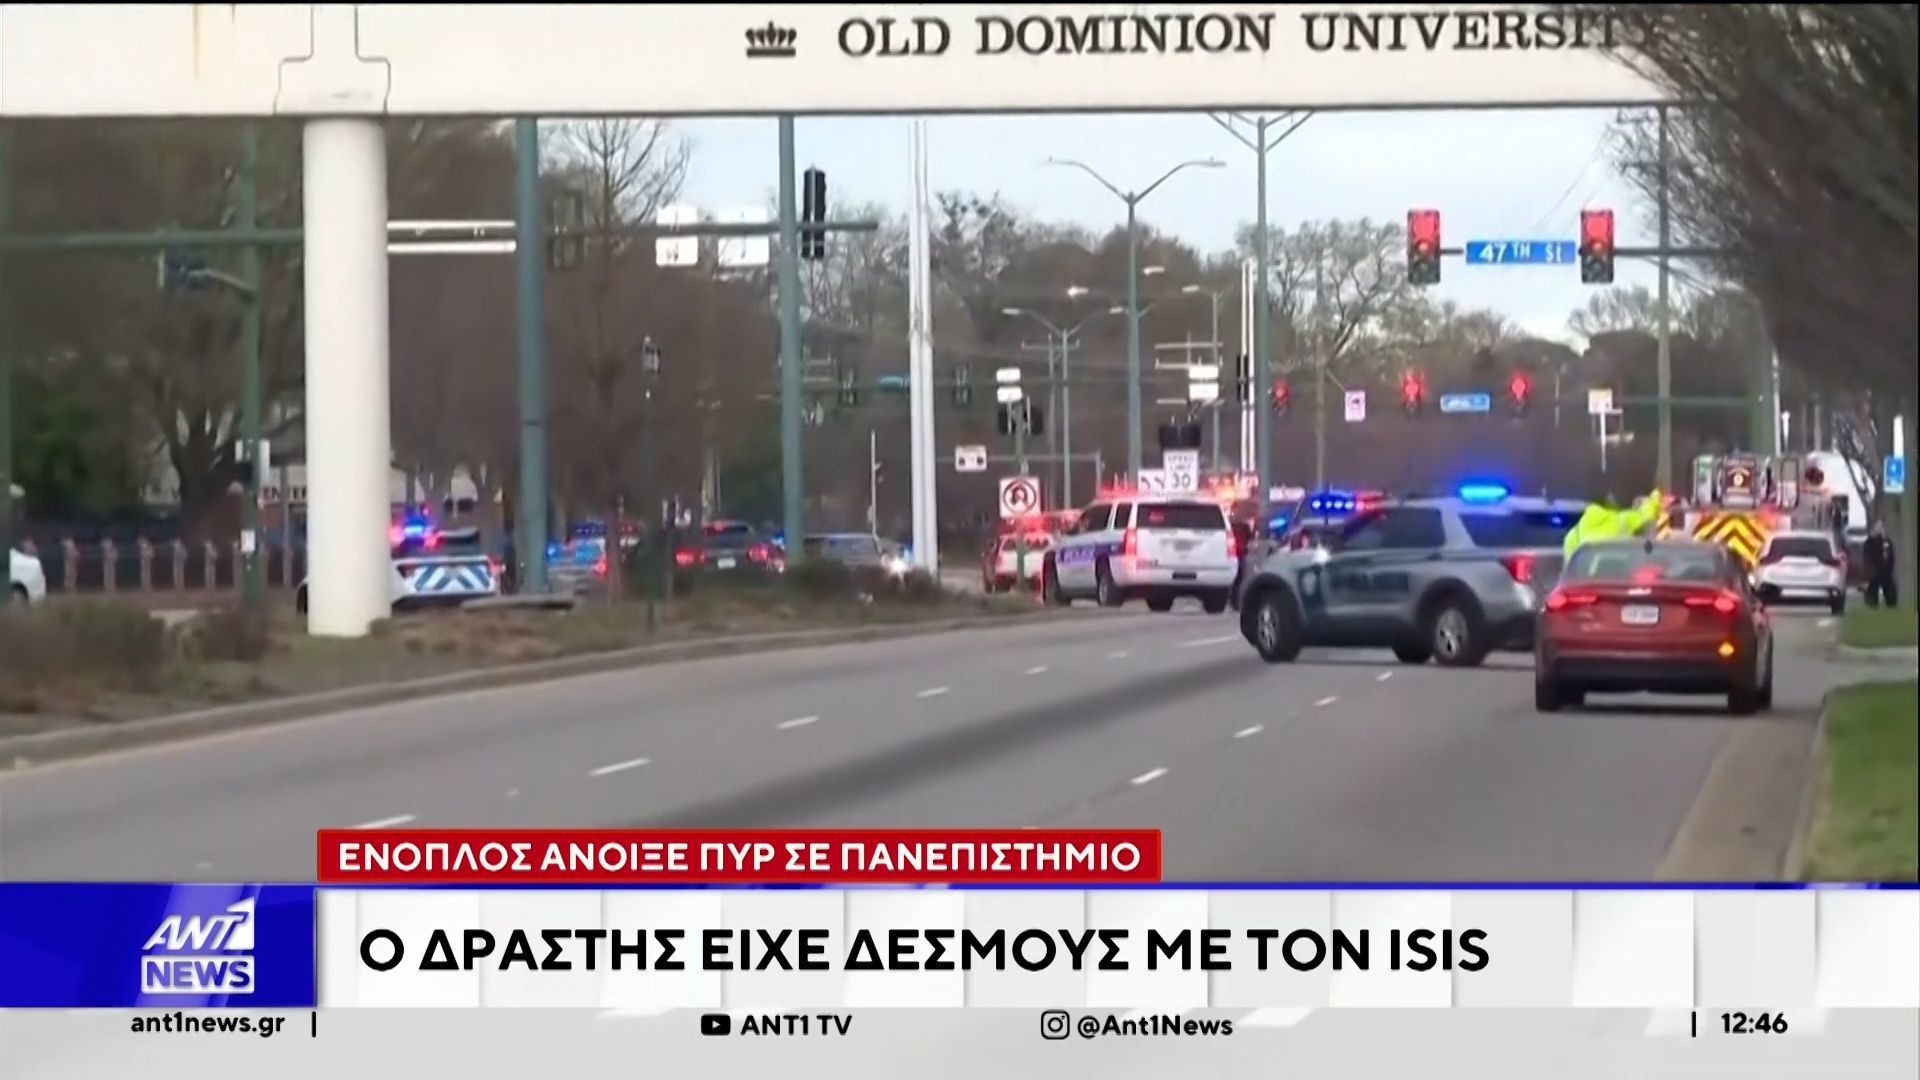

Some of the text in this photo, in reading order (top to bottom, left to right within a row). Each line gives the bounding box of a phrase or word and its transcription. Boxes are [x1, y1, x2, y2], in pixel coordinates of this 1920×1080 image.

[838, 11, 1654, 56] OLD DOMINION UNIVERSIT
